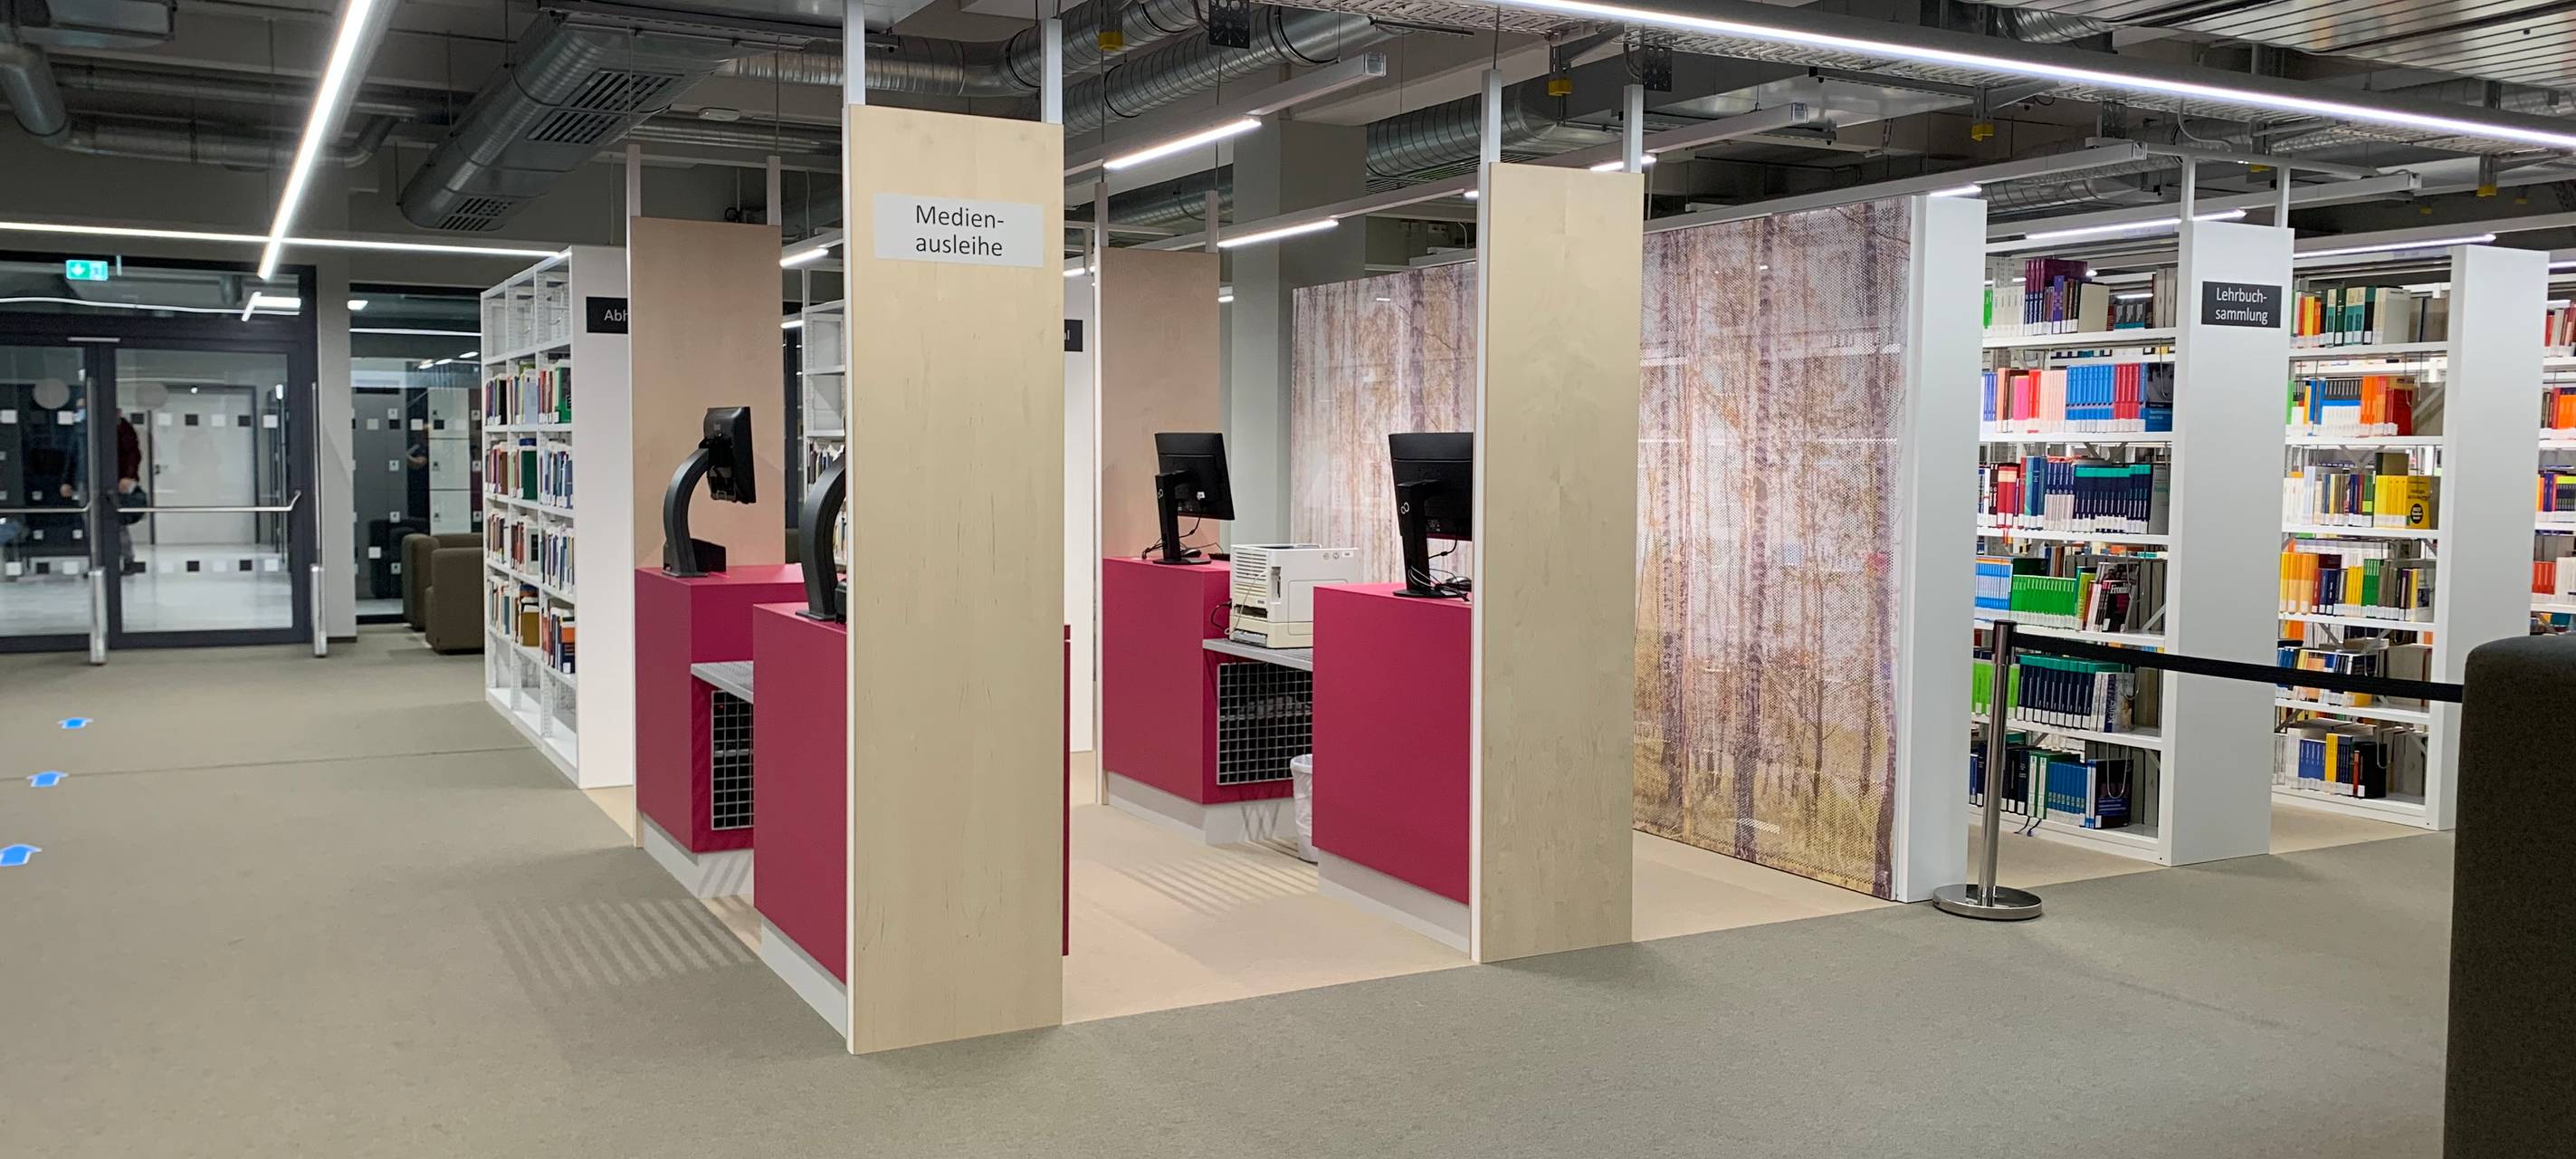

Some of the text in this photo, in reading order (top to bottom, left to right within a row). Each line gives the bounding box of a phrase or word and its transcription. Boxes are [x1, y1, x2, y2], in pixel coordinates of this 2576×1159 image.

[916, 205, 1004, 228] Medien-
[916, 234, 1002, 256] ausleihe
[2216, 287, 2267, 303] Lehrbuch-
[2215, 307, 2268, 325] sammlung
